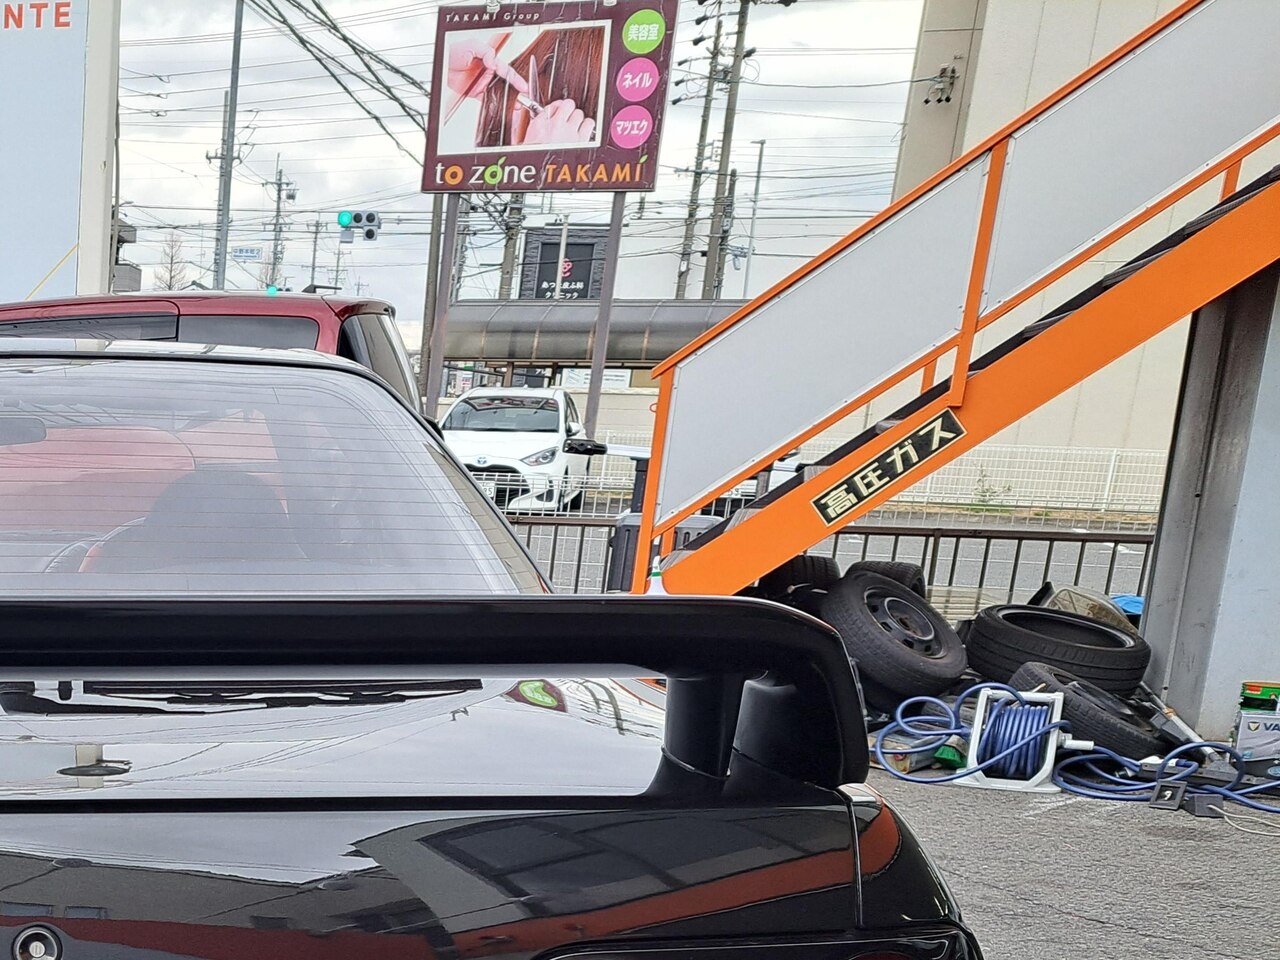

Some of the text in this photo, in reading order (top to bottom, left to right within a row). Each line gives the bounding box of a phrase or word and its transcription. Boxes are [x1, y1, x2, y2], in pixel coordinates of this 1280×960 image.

[445, 12, 540, 23] TAKAMI Group
[627, 24, 660, 41] 美容室
[622, 72, 653, 87] ネイル
[615, 119, 648, 136] マツエク
[435, 155, 648, 185] to zone TAKAMI
[820, 416, 957, 519] 高圧ガス
